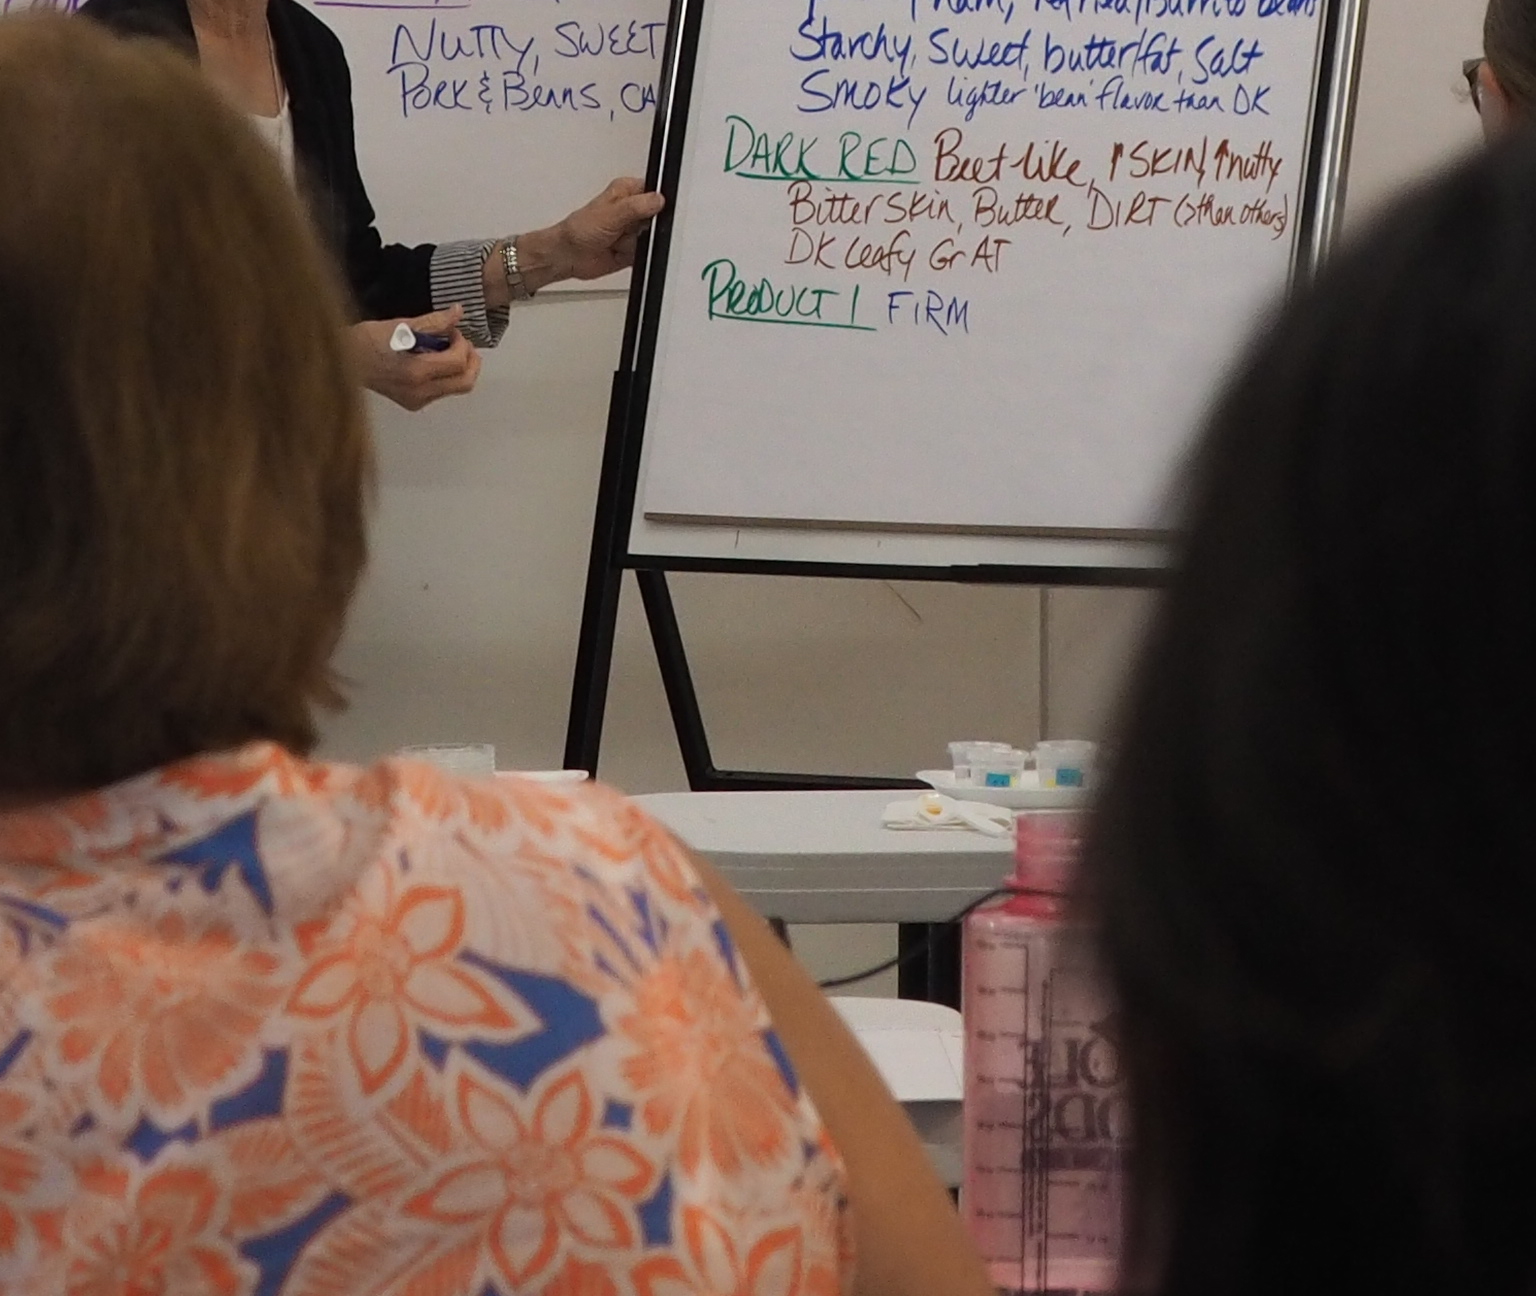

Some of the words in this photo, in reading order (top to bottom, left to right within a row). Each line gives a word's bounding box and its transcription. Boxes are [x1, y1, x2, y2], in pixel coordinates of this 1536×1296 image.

[1232, 82, 1272, 116] DK
[723, 114, 821, 179] DARK
[838, 131, 917, 181] RED
[786, 178, 885, 226] Bitter
[1087, 188, 1173, 231] DIRT
[784, 226, 837, 270] DK
